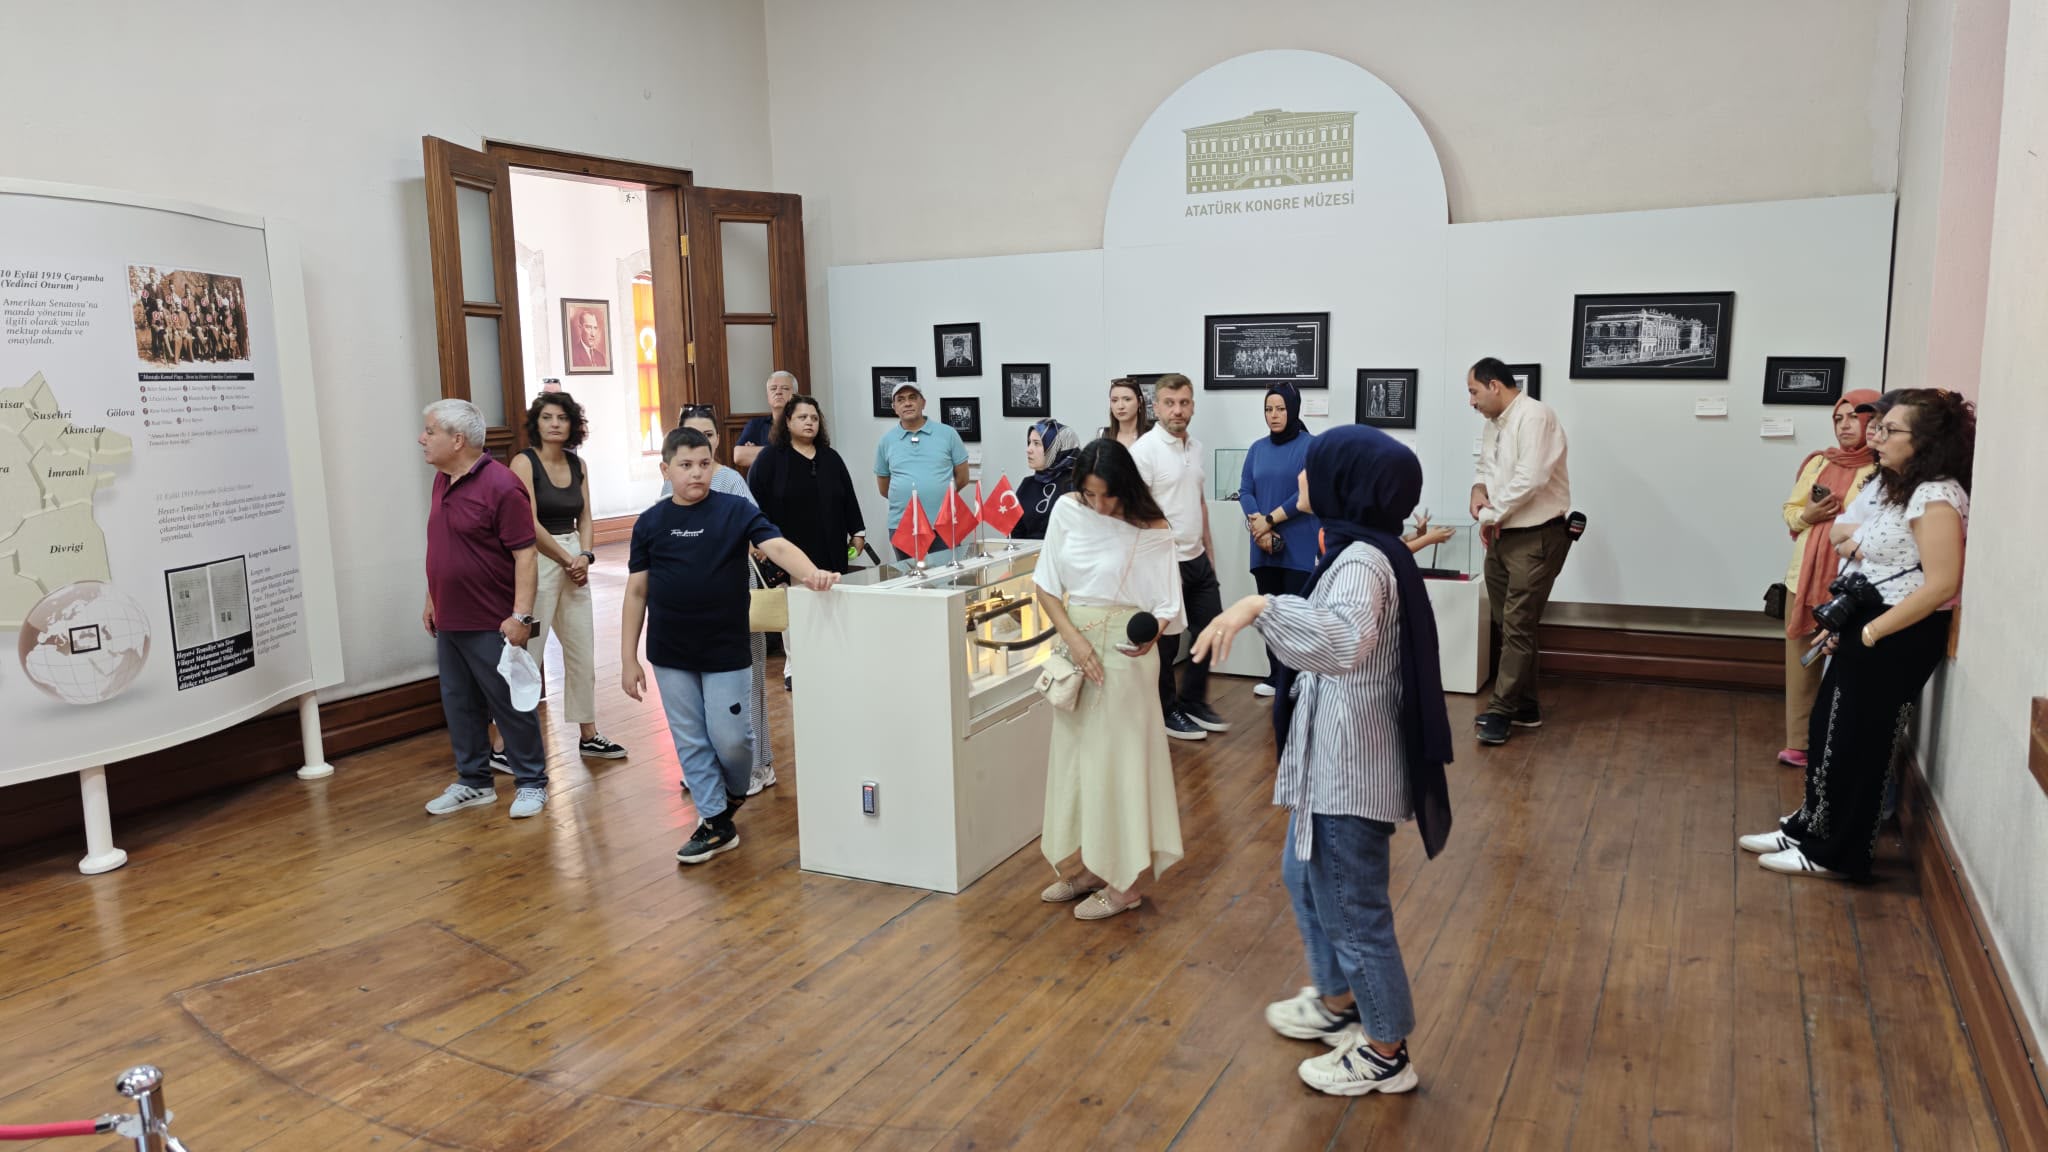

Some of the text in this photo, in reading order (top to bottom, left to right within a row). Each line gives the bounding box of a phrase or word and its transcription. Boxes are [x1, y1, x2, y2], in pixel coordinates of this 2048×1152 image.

[1185, 189, 1354, 217] ATATÜRK KONGRE MÜZESİ
[0, 269, 104, 282] 10 Eylül 1919 Çarşamba
[0, 279, 38, 289] (Yedinci
[3, 298, 46, 307] Amerikan
[4, 308, 35, 316] manda
[75, 309, 86, 317] ile
[5, 316, 90, 328] ilgili olarak yazılan
[6, 327, 39, 337] mektup
[41, 326, 72, 335] okundu
[7, 336, 55, 346] onaylandı.
[106, 408, 135, 418] Gölova
[62, 424, 106, 435] Akıncılar
[48, 467, 85, 478] İmranlı
